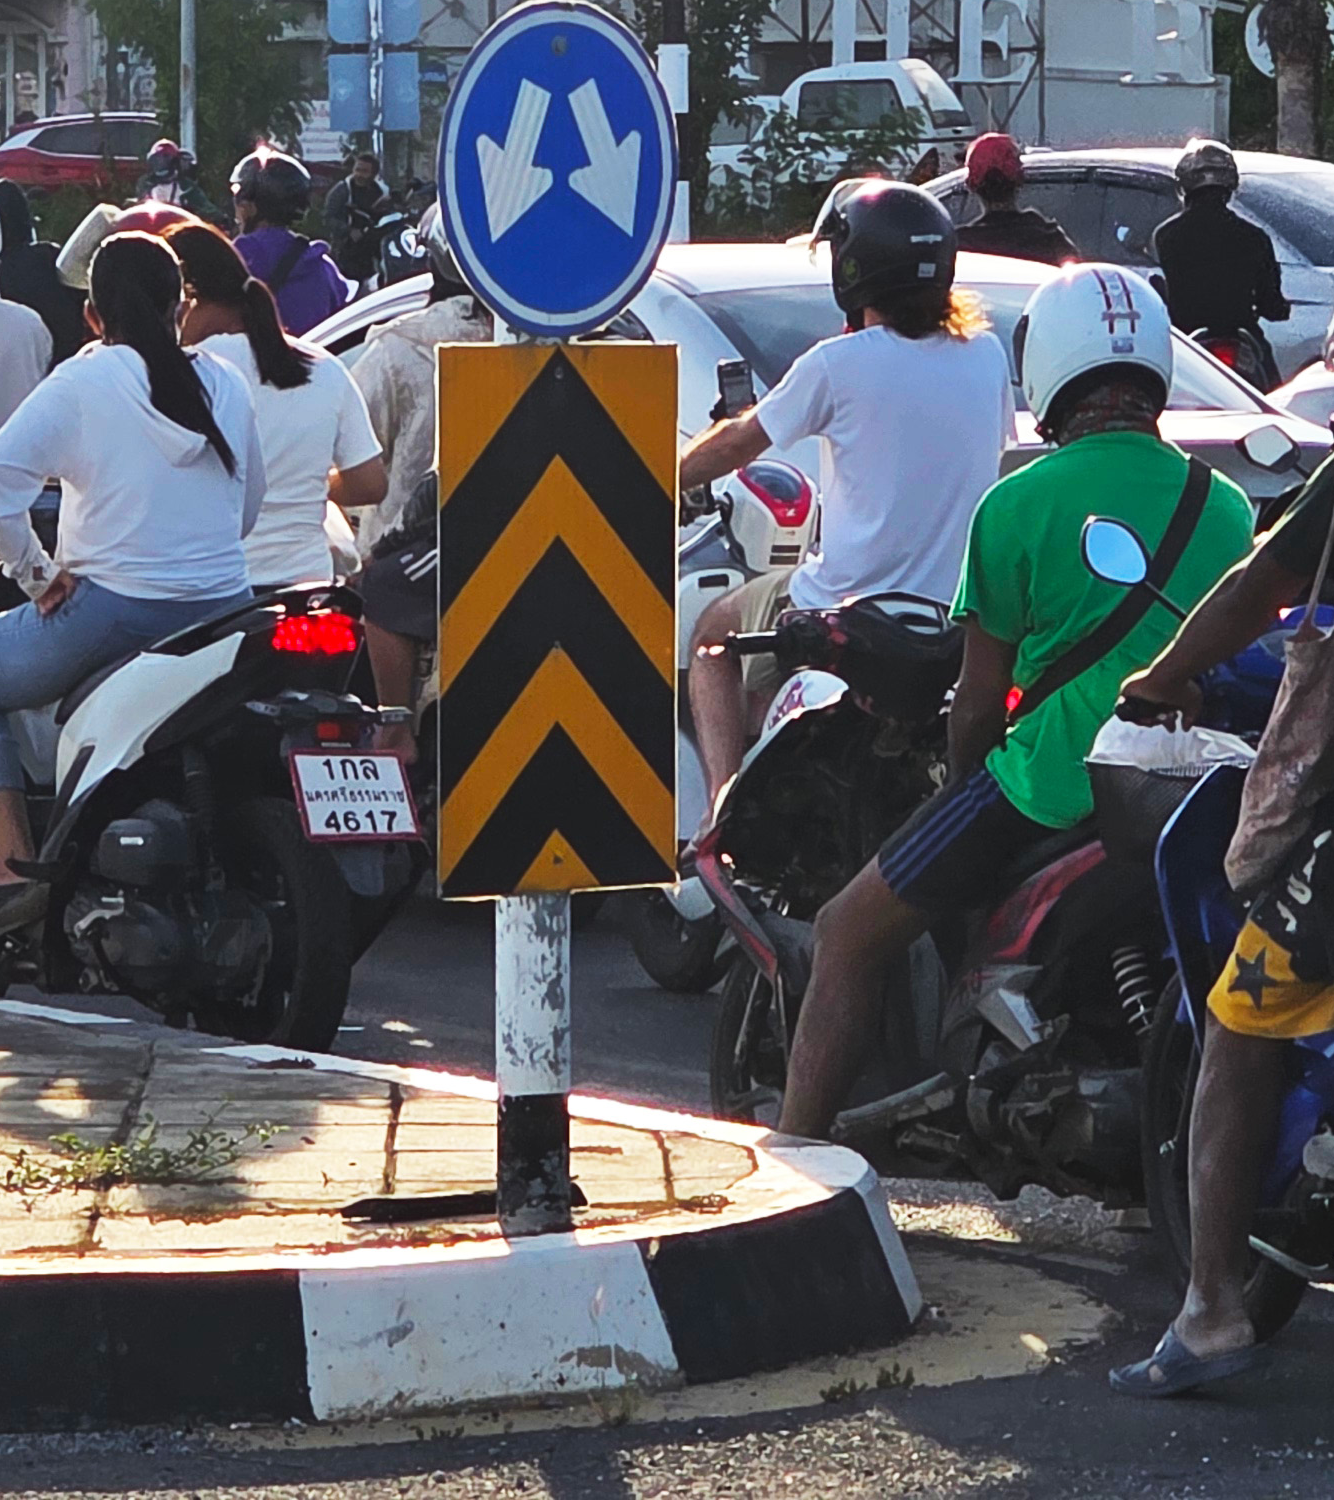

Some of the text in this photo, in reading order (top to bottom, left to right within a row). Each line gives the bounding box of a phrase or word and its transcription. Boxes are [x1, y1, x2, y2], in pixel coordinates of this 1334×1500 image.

[322, 758, 380, 781] 1กล
[305, 787, 405, 804] นครศรีธรรมราช
[325, 810, 398, 833] 4617
